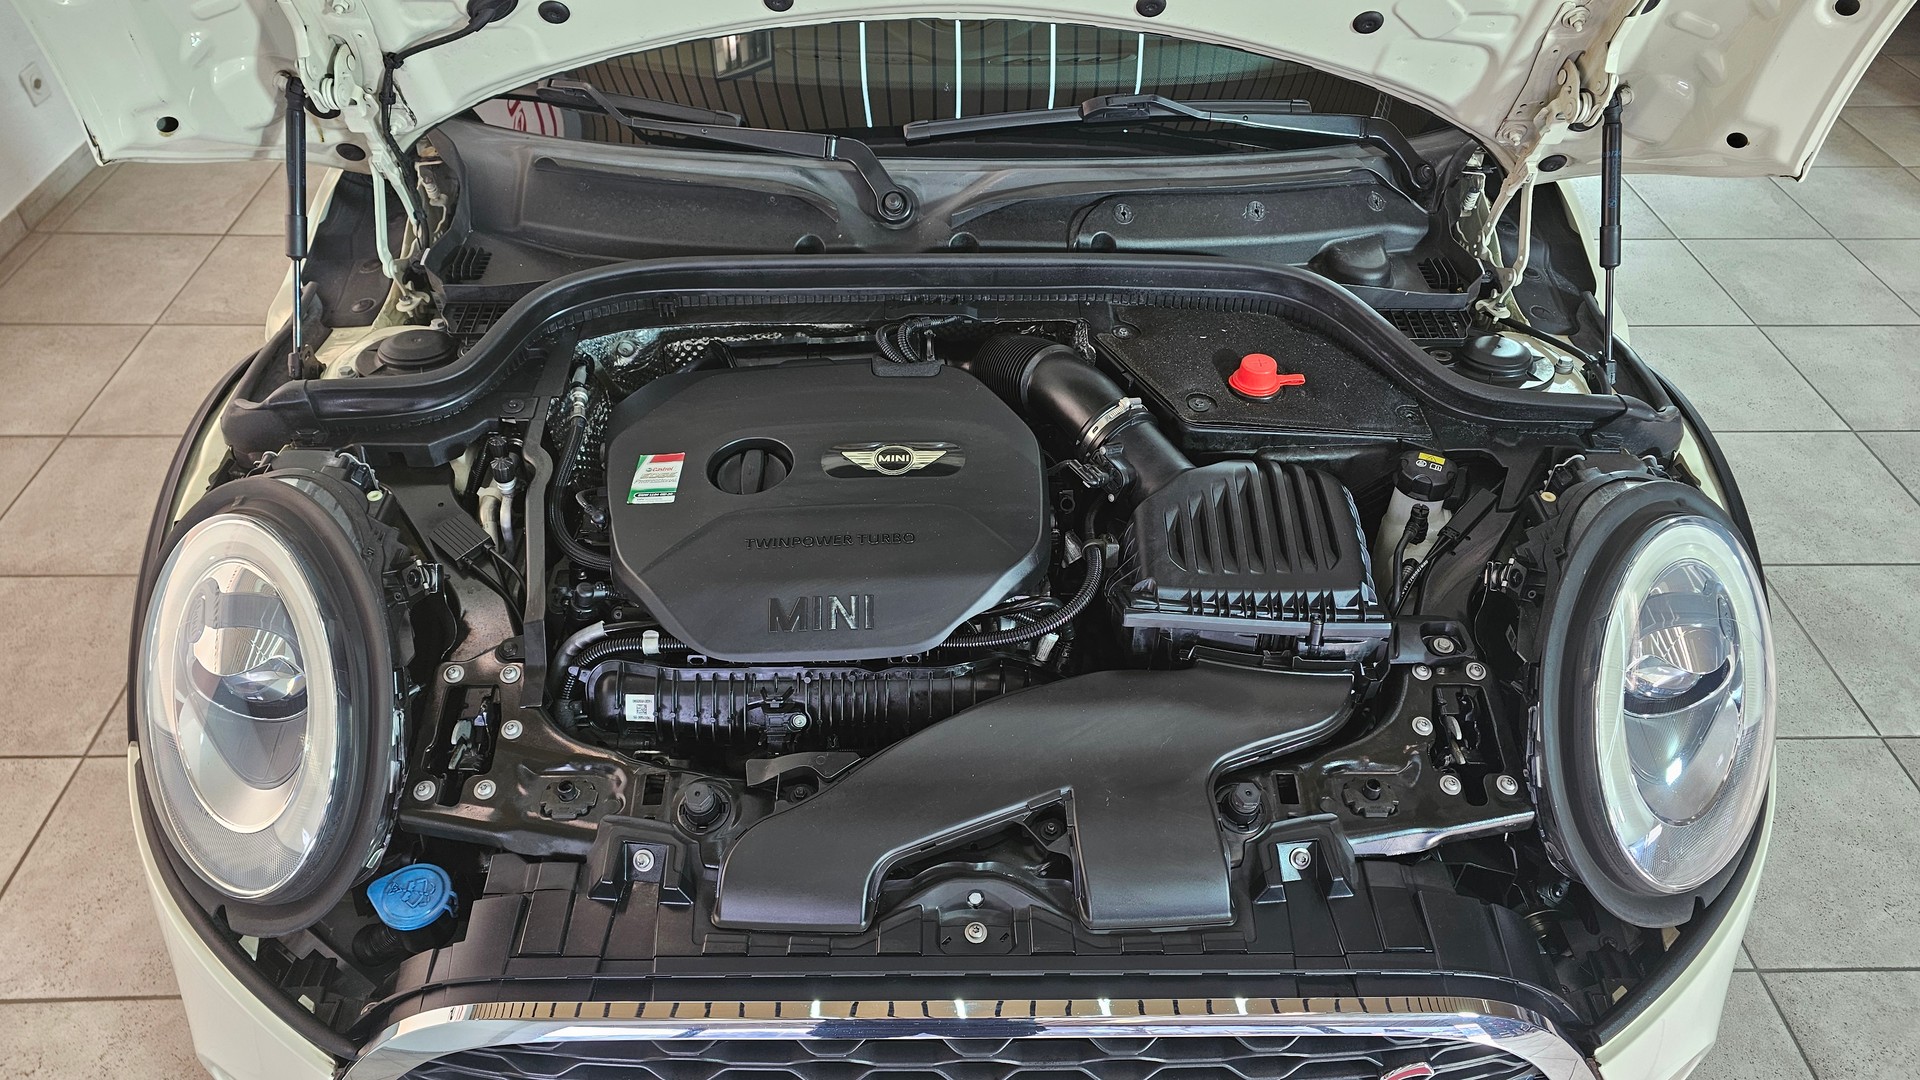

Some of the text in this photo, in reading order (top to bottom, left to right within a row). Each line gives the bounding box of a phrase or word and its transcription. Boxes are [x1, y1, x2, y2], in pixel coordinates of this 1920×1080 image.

[878, 454, 910, 462] MINI
[744, 532, 917, 549] TWINPOWER TURBO
[768, 594, 875, 633] MINI
